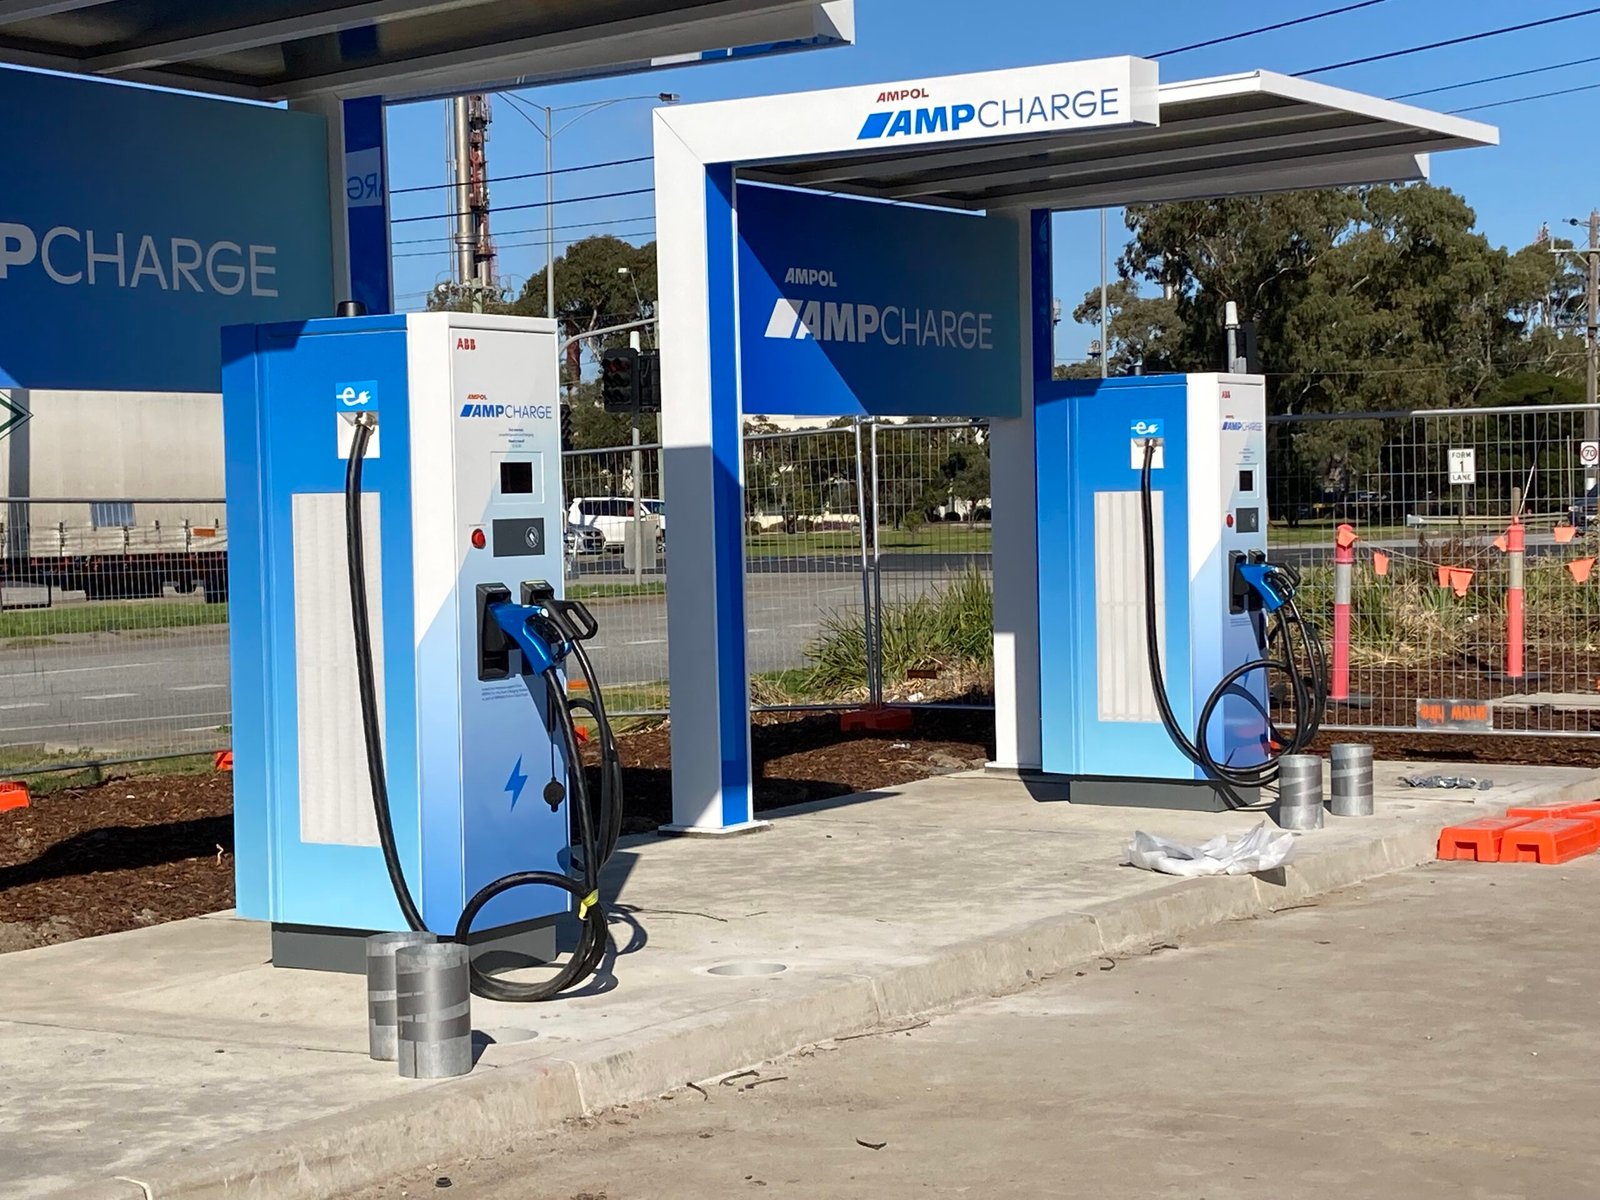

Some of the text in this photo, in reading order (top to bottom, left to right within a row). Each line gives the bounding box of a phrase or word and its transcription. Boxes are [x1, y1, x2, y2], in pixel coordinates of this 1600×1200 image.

[876, 88, 929, 103] AMPOL
[886, 88, 1119, 137] AMPCHARGE
[0, 222, 279, 298] PCHARGE
[785, 267, 837, 287] AMPOL
[795, 301, 993, 350] AMPCHARGE
[456, 338, 476, 350] ABB
[472, 404, 552, 419] AMPCHARGE
[1451, 451, 1471, 459] FORM
[1585, 449, 1594, 457] 70
[1460, 460, 1464, 473] 1
